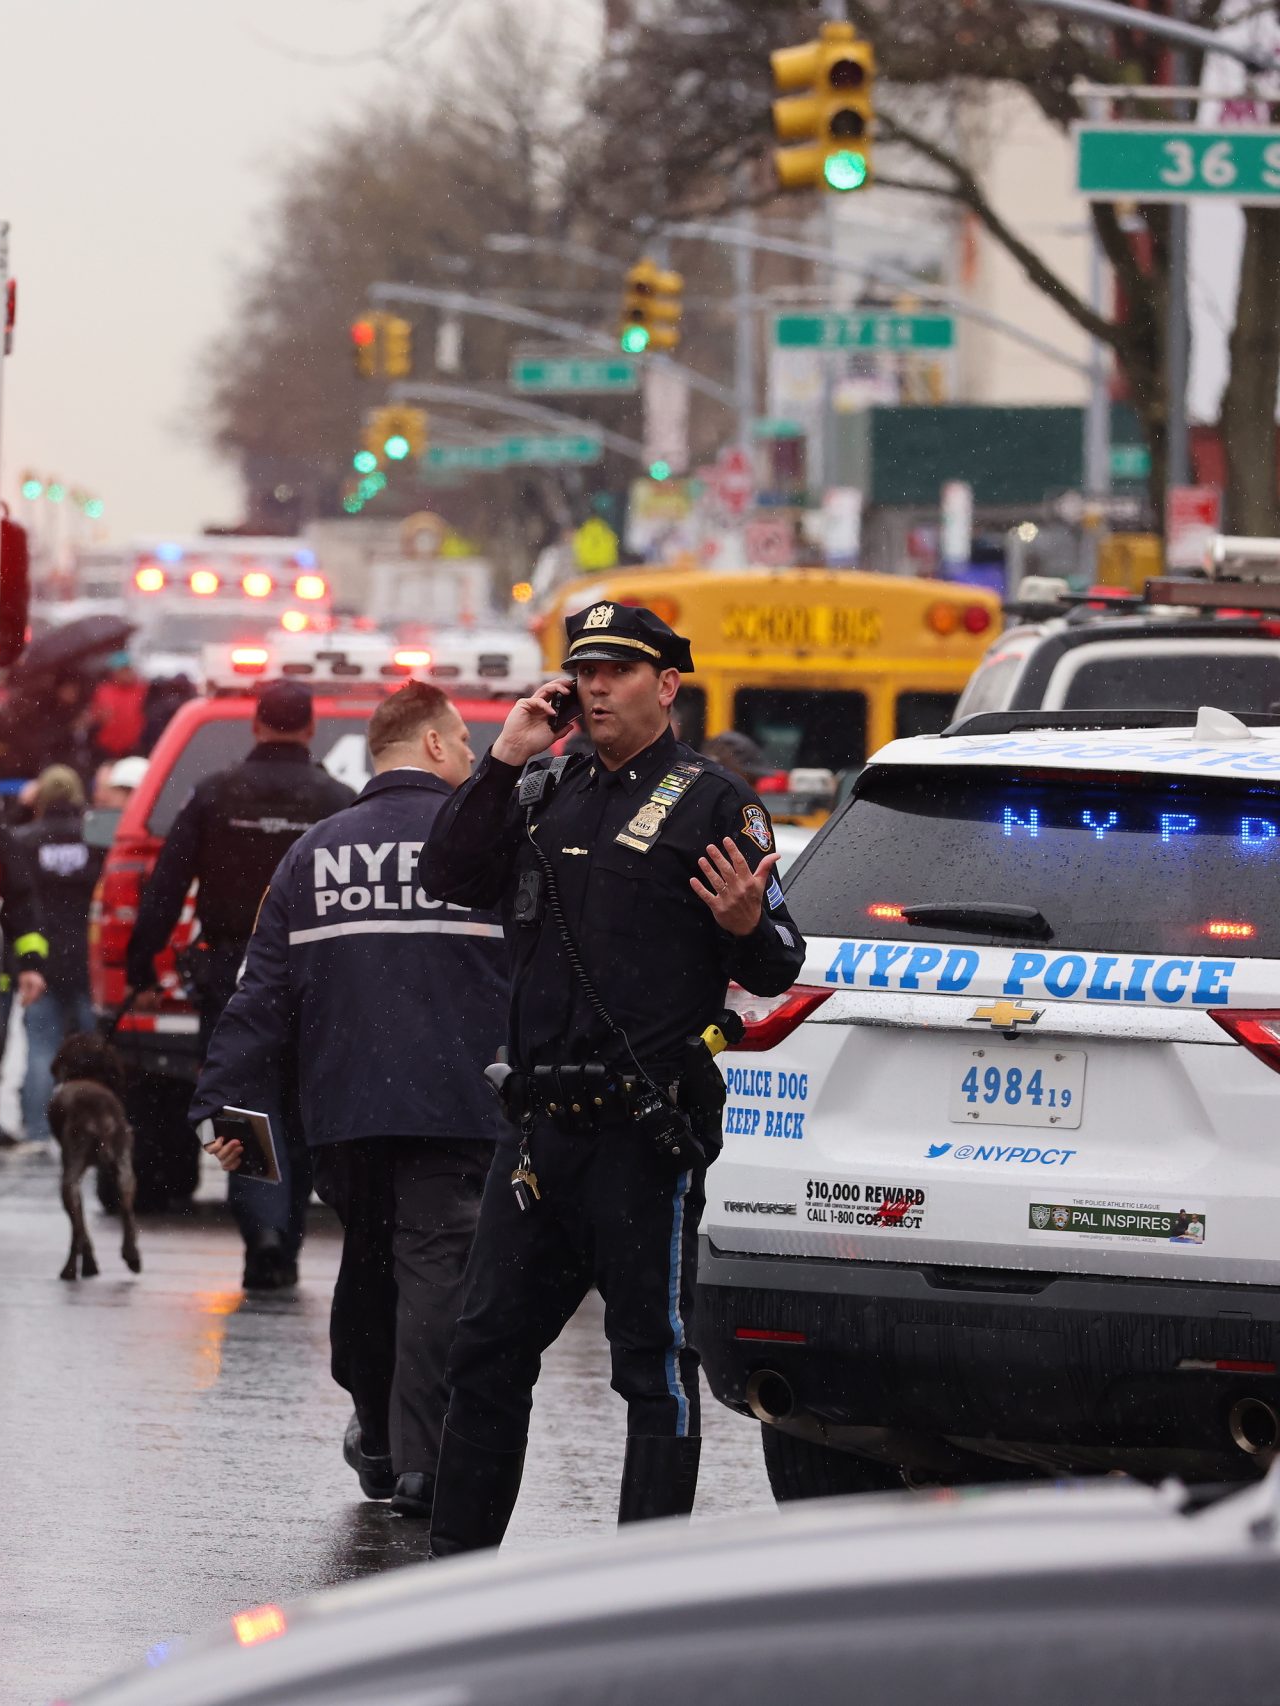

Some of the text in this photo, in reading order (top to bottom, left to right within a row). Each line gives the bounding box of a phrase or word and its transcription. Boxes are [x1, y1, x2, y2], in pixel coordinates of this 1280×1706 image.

[1160, 140, 1237, 187] 36
[628, 769, 638, 781] 5
[314, 841, 426, 888] NYP
[824, 941, 1237, 1005] NYPD POLICE
[726, 1067, 808, 1101] POLICE DOG
[961, 1065, 1073, 1109] 4984 19
[724, 1106, 806, 1140] KEEP BACK
[953, 1143, 1078, 1166] @NYPDCT
[806, 1179, 926, 1206] $10,000 REWARD
[1073, 1198, 1161, 1210] THE POLICE ATHLETIC LEAGUE
[723, 1200, 797, 1215] TRAVERSE
[807, 1208, 827, 1222] CALL
[830, 1209, 855, 1225] 1-800
[1072, 1211, 1171, 1231] PAL INSPIRES
